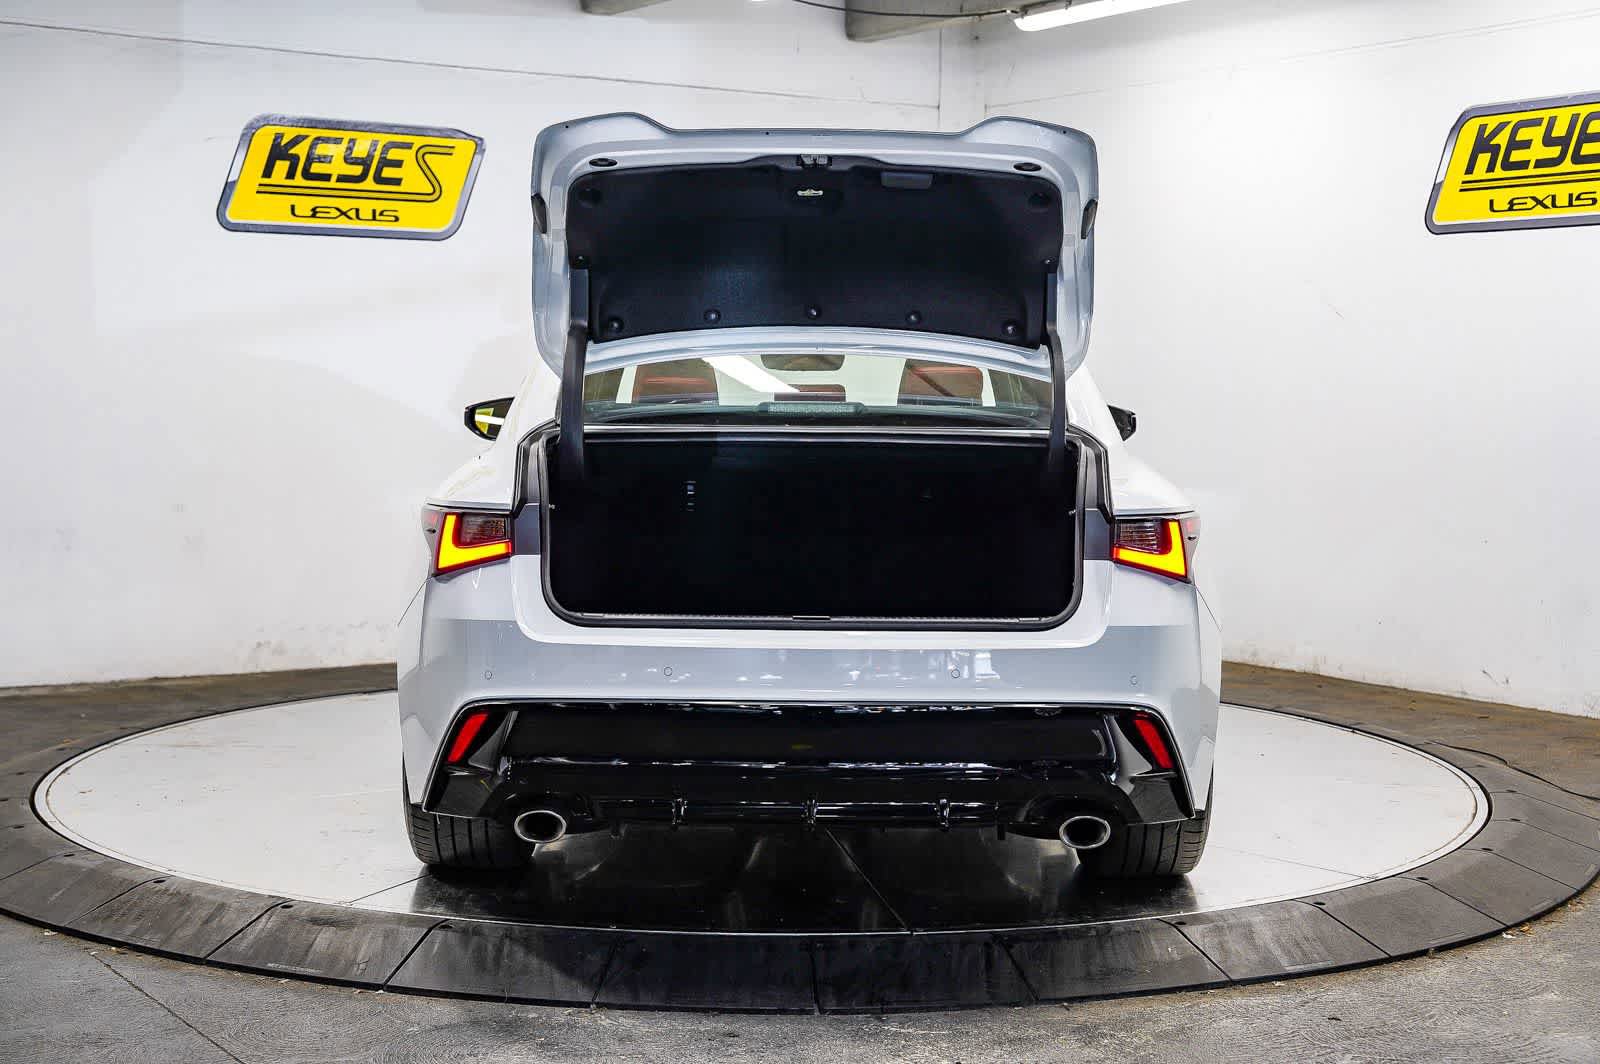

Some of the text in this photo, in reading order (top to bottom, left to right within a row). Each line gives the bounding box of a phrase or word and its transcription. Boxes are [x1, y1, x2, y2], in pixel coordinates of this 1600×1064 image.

[258, 132, 455, 202] KEYES
[290, 204, 399, 222] LEXUS
[1489, 191, 1598, 213] LEXUS
